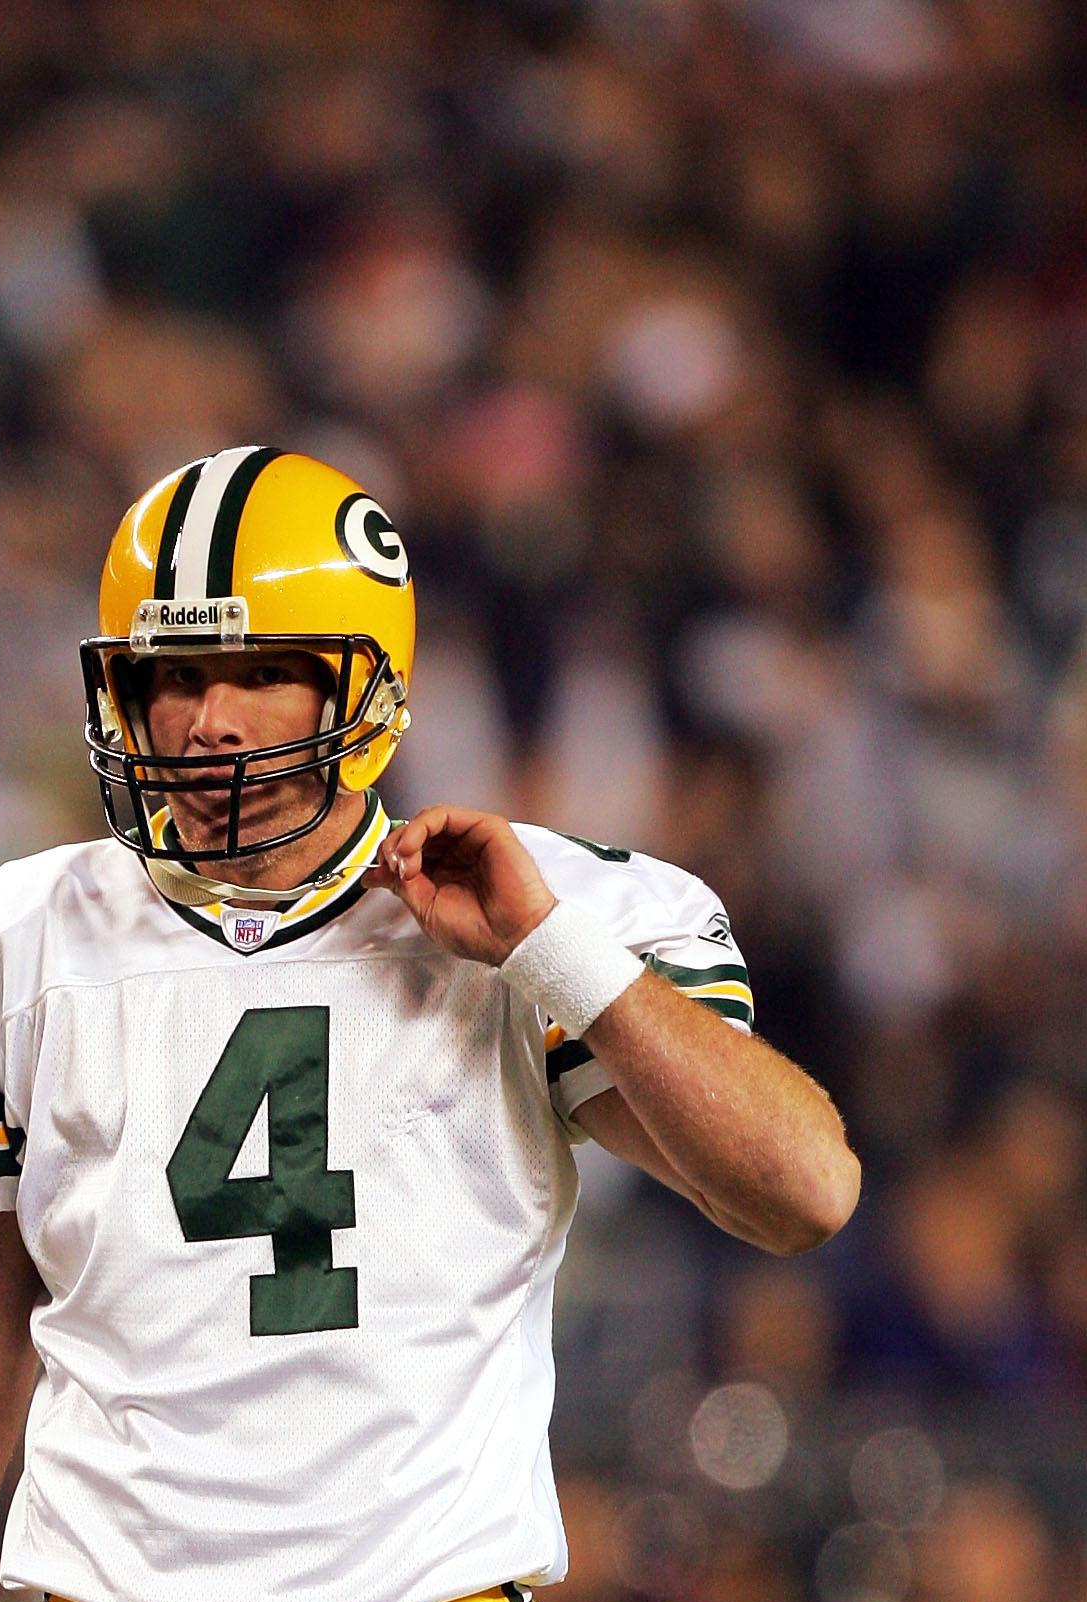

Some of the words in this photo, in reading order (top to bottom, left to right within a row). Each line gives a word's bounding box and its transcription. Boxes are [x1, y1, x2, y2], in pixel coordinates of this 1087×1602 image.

[342, 496, 410, 581] G
[160, 604, 219, 626] Riddell
[236, 927, 262, 942] NFL
[165, 1005, 359, 1336] 4
